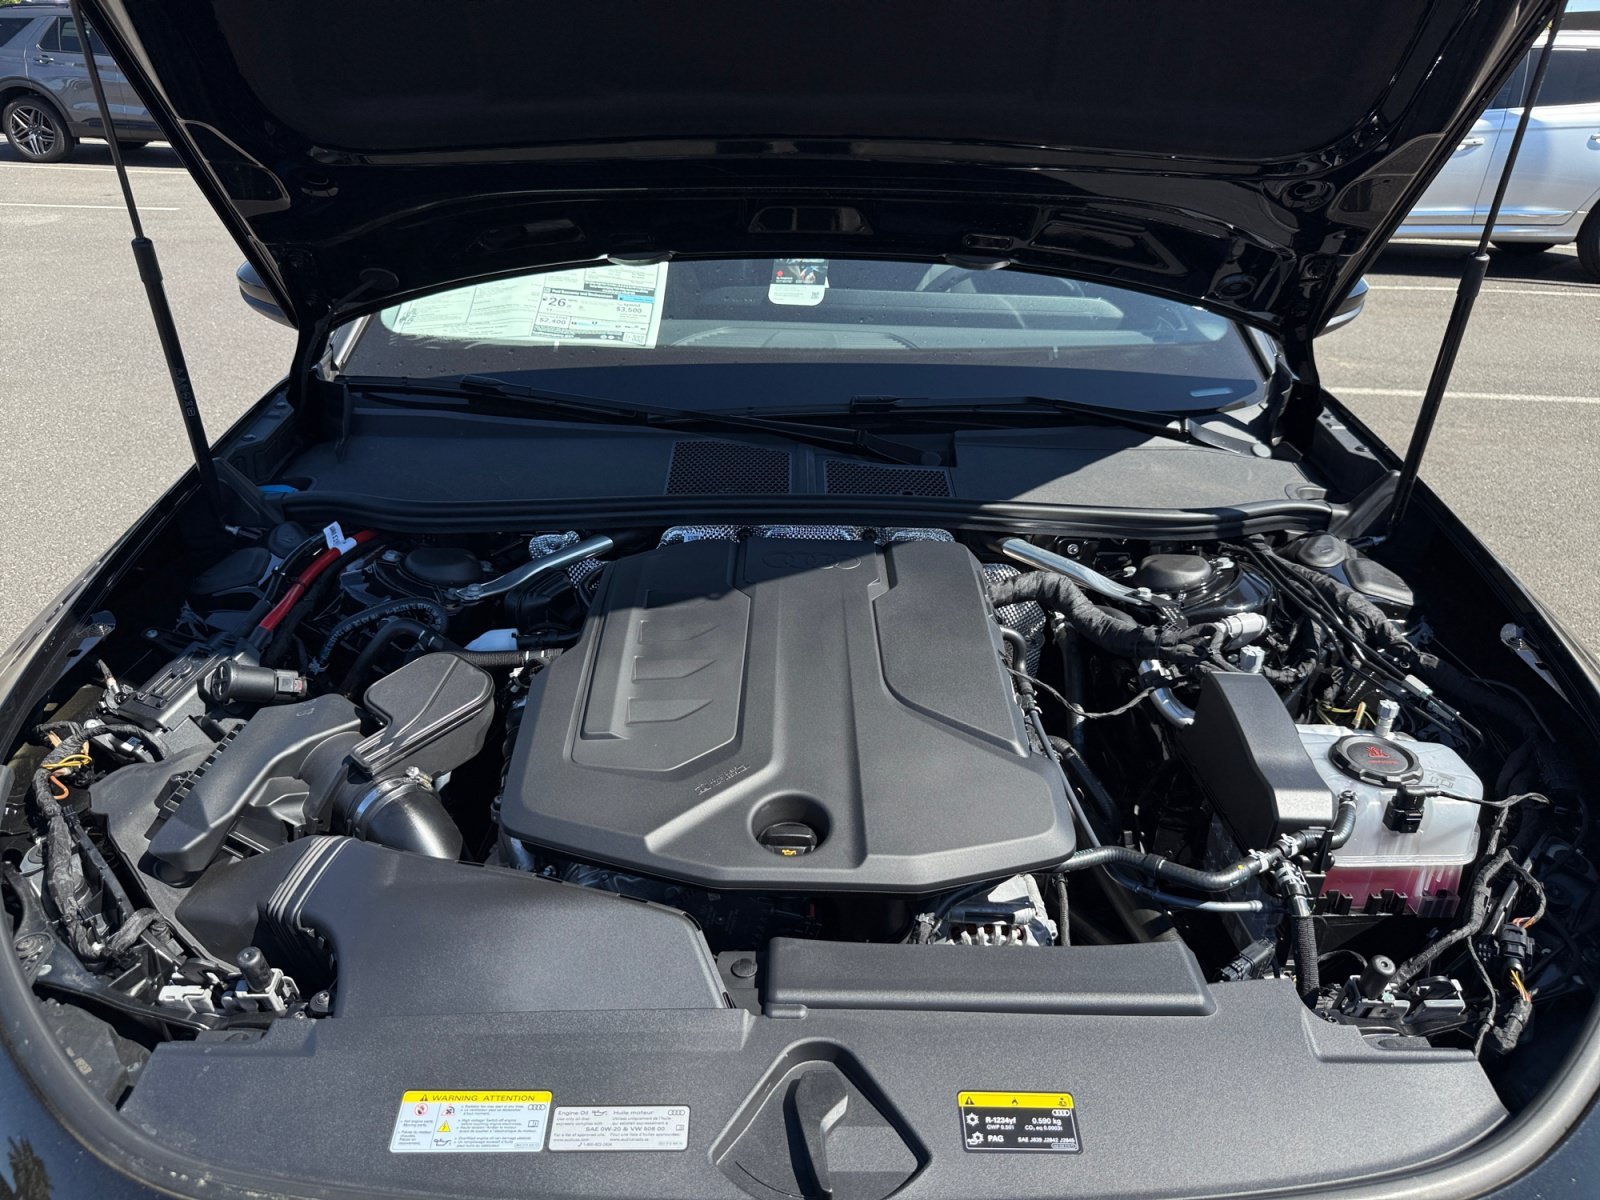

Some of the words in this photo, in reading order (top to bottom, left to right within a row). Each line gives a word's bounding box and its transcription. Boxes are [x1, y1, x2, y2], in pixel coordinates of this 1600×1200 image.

[548, 297, 567, 307] 26
[539, 317, 566, 325] $2,400
[985, 1116, 1016, 1125] R-1234yf
[1052, 1117, 1062, 1126] kg
[987, 1134, 1004, 1142] PAG
